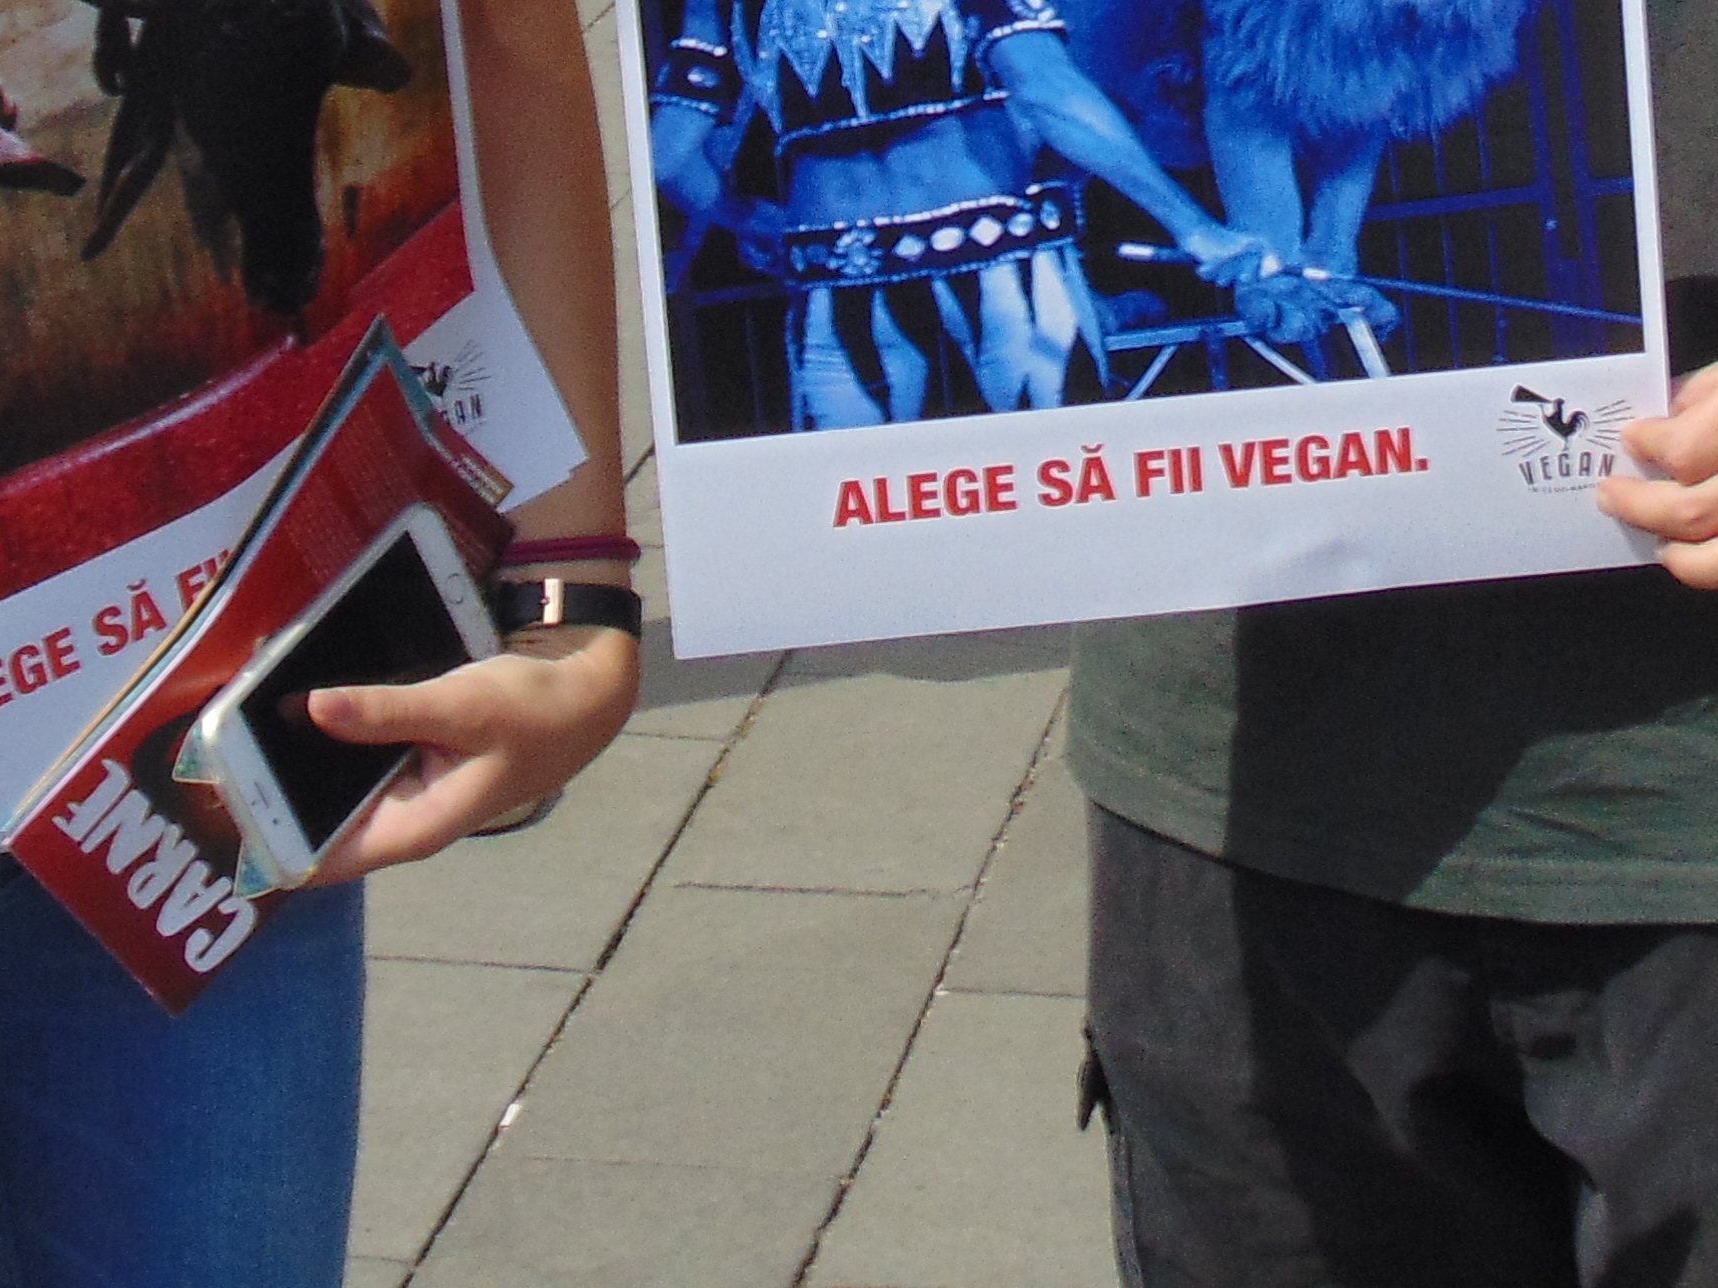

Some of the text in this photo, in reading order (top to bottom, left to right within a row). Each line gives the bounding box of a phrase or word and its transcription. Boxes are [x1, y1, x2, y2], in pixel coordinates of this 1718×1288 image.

[831, 426, 1430, 529] ALEGE SĂ FII VEGAN.
[1518, 451, 1616, 485] VEGAN
[92, 578, 167, 656] SĂ
[51, 757, 258, 973] CARNE
